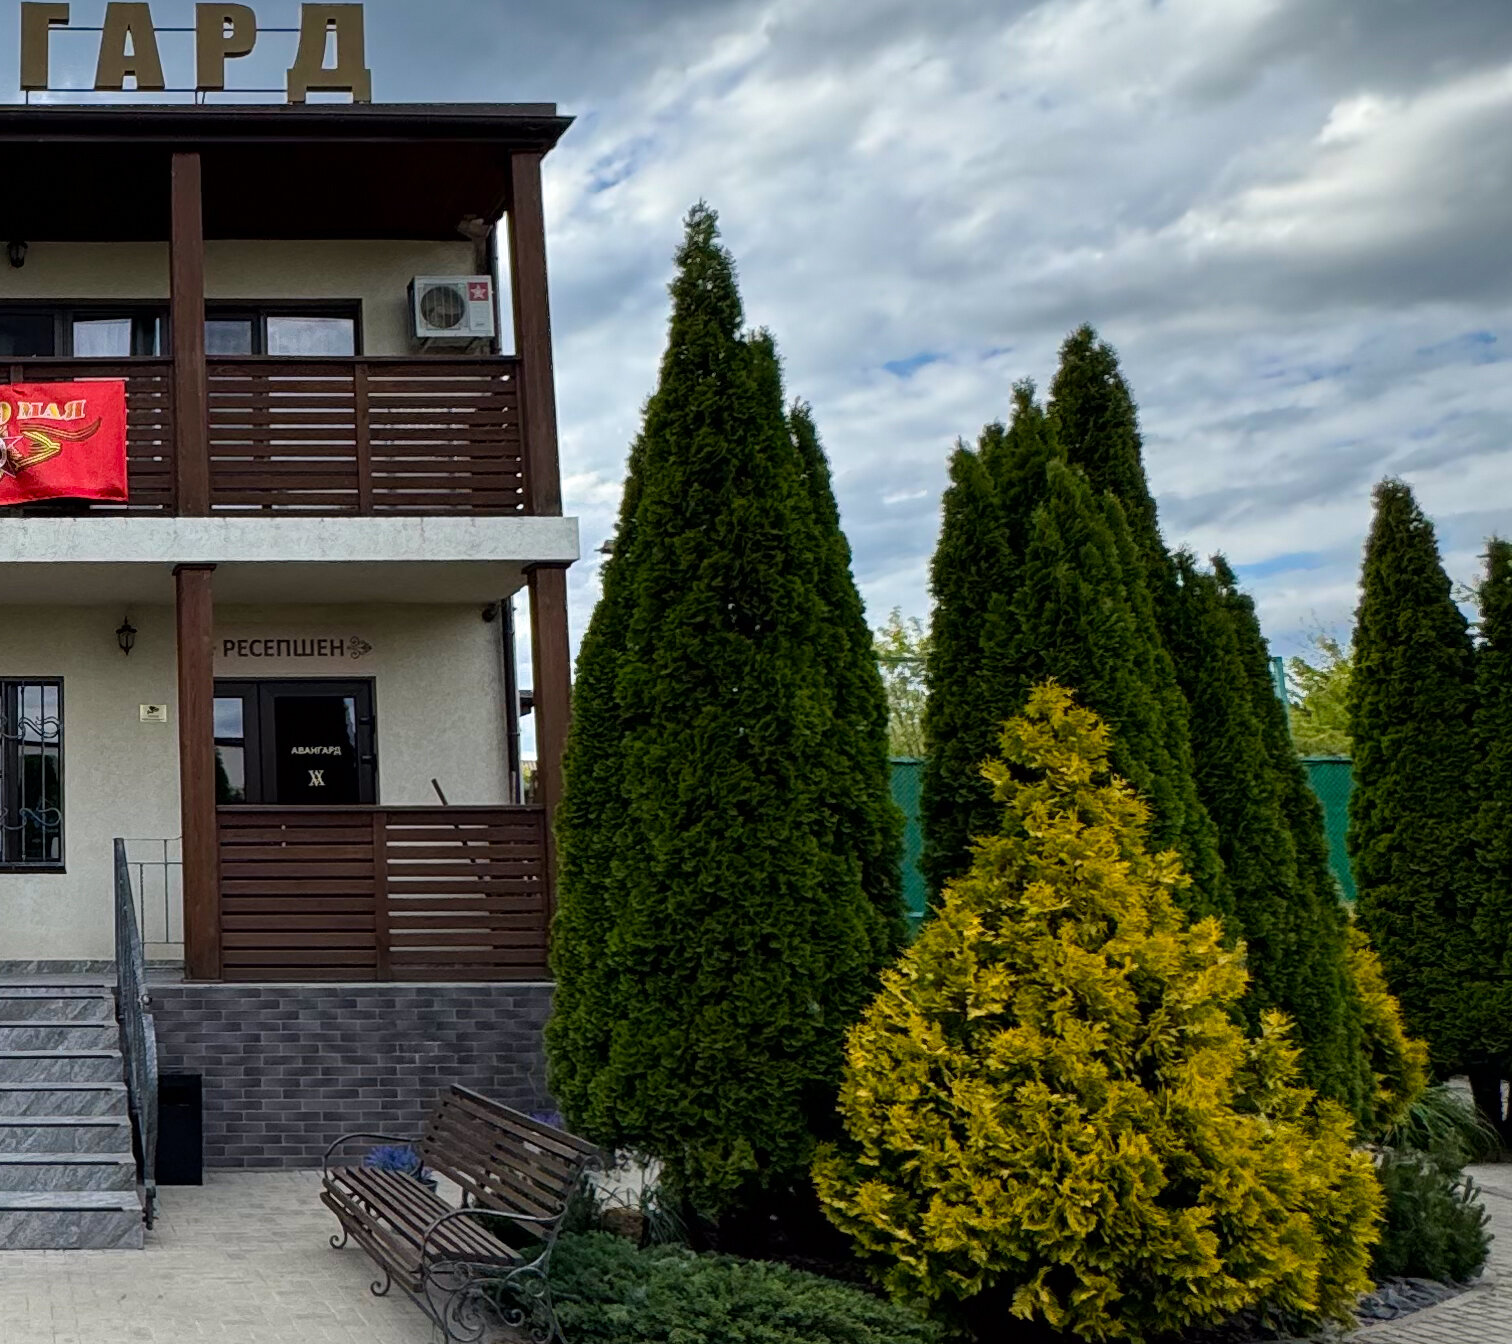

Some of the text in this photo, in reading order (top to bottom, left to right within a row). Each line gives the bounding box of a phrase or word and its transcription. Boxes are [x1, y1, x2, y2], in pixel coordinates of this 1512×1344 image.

[17, 399, 87, 421] МАЯ
[223, 638, 345, 657] РЕСЕПШЕН
[290, 745, 343, 756] АВАНГАРД
